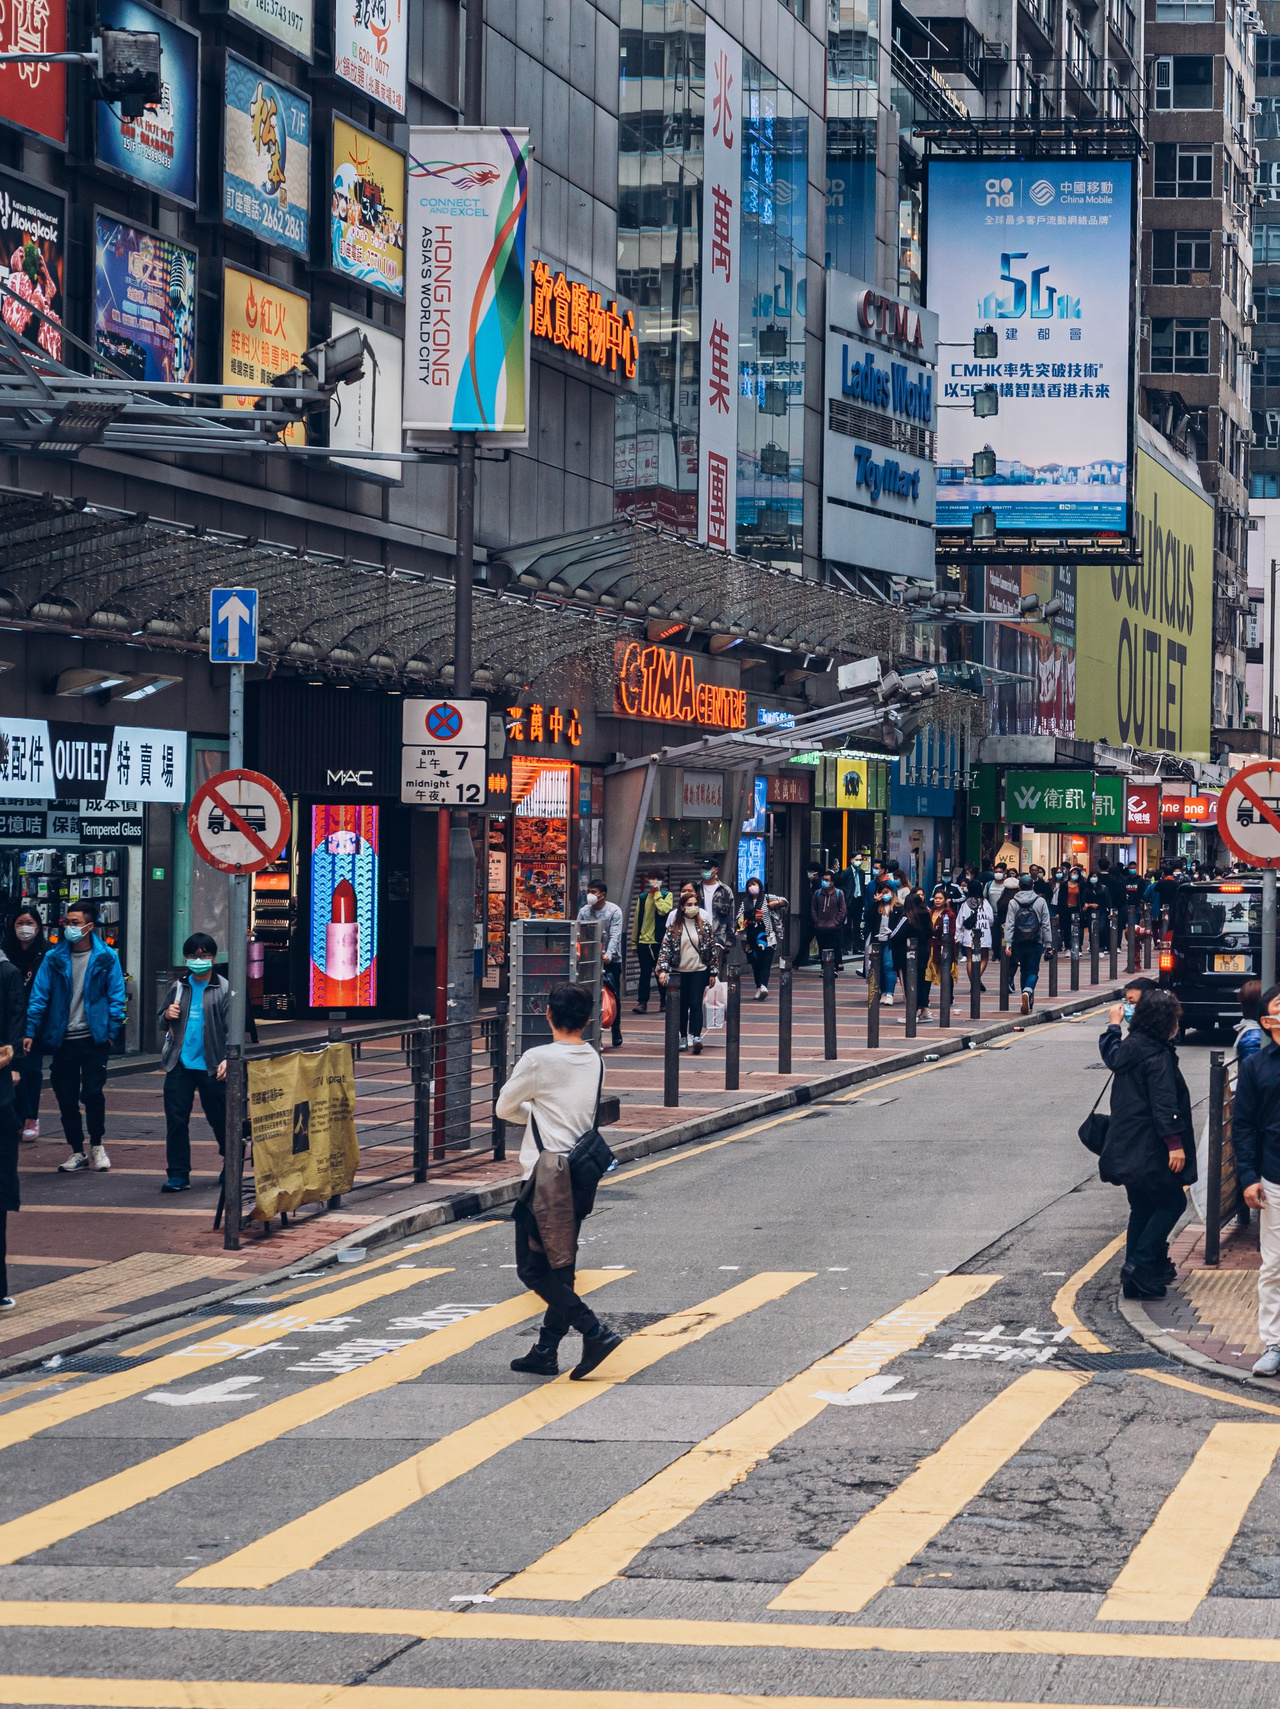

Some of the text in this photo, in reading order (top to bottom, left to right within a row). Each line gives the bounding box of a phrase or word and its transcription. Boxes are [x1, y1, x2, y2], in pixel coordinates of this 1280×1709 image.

[288, 12, 303, 32] 1977
[358, 46, 373, 68] 6201
[1060, 181, 1113, 195] 中國移動
[419, 198, 480, 208] CONNECT
[1060, 195, 1113, 204] China Mobile
[430, 207, 489, 217] AND EXCEL
[11, 214, 58, 243] Mongkok
[418, 226, 432, 385] ASIA'S WORLD CITY
[431, 226, 453, 386] HONG KONG
[707, 49, 734, 551] 兆萬集團
[260, 297, 287, 341] 紅火
[531, 260, 639, 379] 飲食購物中心
[858, 289, 925, 349] CTMA
[974, 327, 1082, 341] 建都會
[841, 343, 933, 423] Ladies World
[944, 383, 1110, 399] 以5G構智慧香港未來
[620, 642, 747, 728] CTMA CENTRE
[1117, 617, 1187, 753] OUTLET
[55, 740, 108, 781] OUTLET
[117, 740, 174, 788] 特賣場
[416, 758, 441, 770] 上午
[455, 751, 469, 771] 7
[406, 779, 450, 789] midnight
[456, 784, 480, 803] 12
[415, 789, 440, 801] 午夜
[1043, 788, 1086, 810] 衛訊
[1185, 804, 1204, 813] one
[82, 822, 142, 839] Tempered Glass
[1220, 963, 1239, 971] 169
